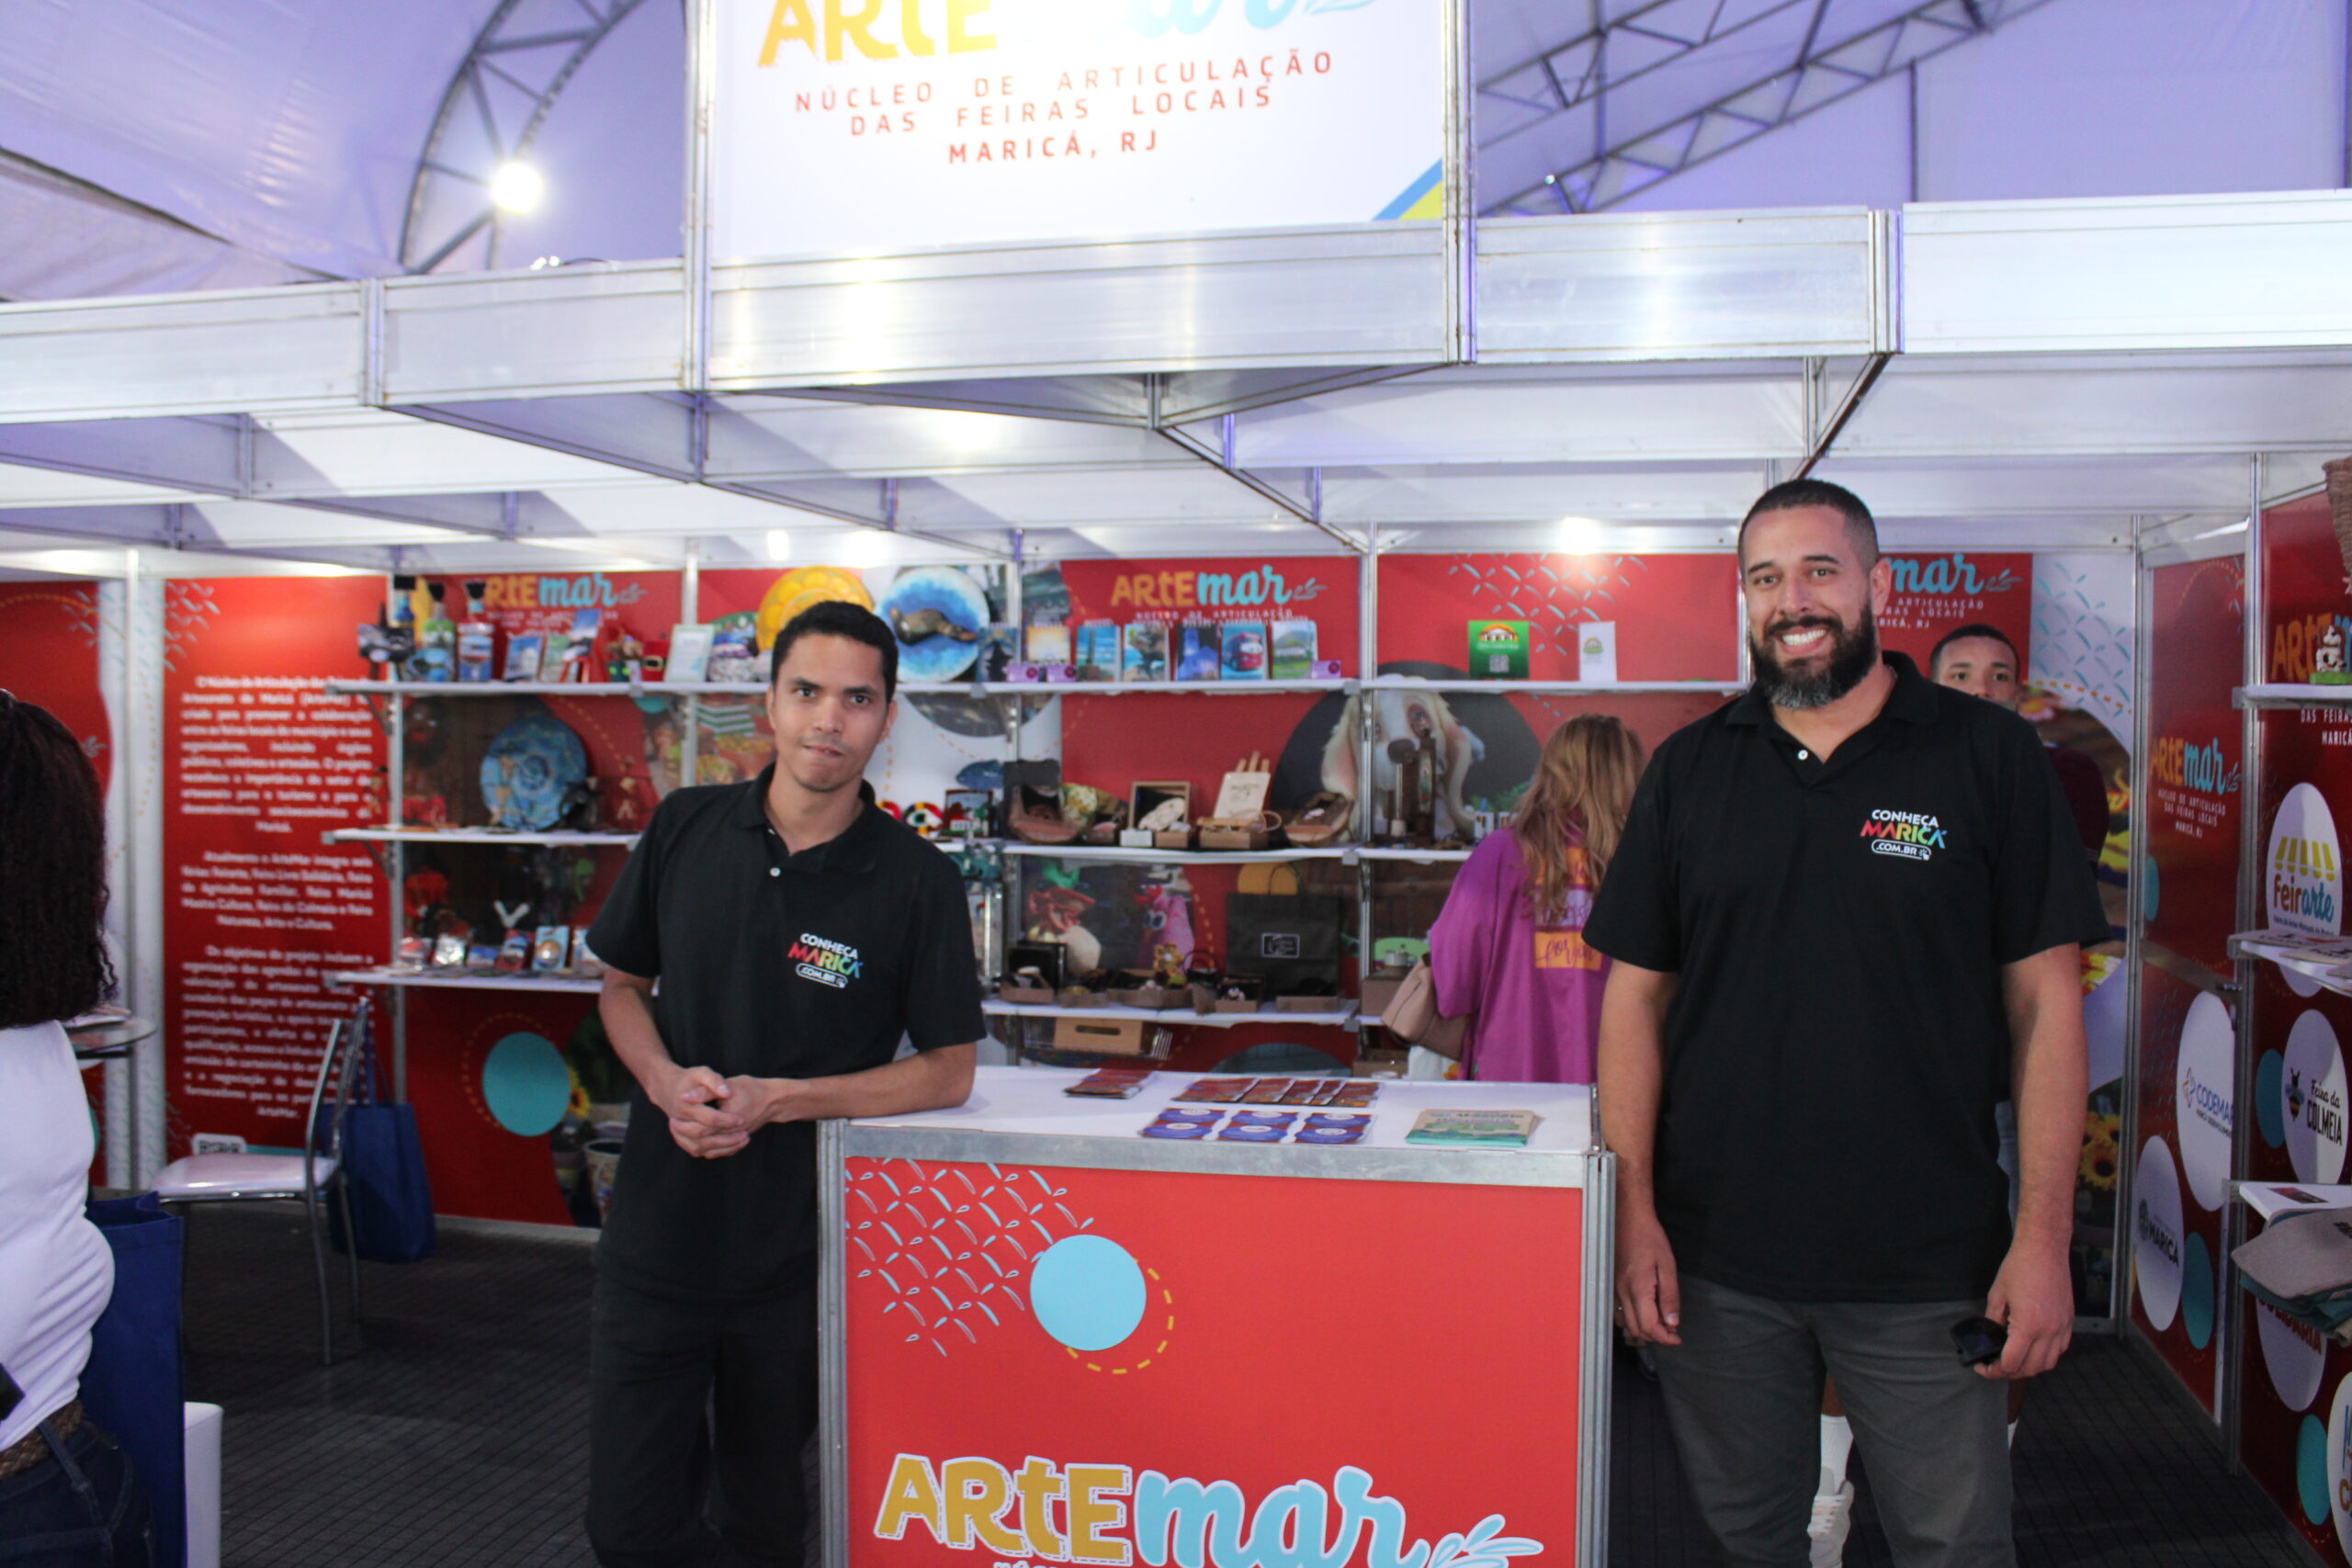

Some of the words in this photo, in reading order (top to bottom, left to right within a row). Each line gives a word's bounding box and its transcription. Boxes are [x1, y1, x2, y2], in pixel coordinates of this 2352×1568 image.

[795, 82, 933, 112] NÚCLEO
[975, 75, 1013, 98] DE
[1057, 49, 1330, 91] ARTICULAÇÃO
[851, 112, 915, 136] DAS
[957, 98, 1088, 127] FEIRAS
[1132, 85, 1271, 115] LOCAIS
[949, 130, 1097, 164] MARICÁ,
[1121, 130, 1156, 152] RJ
[2324, 708, 2352, 723] FEIRA
[1860, 819, 1948, 849] MARICÁ
[1871, 809, 1939, 829] CONHEÇA
[1876, 842, 1917, 856] .COM.BR
[787, 942, 863, 978] MARICÁ
[800, 932, 858, 960] CONHEÇA
[2307, 1100, 2342, 1146] COLMEIA
